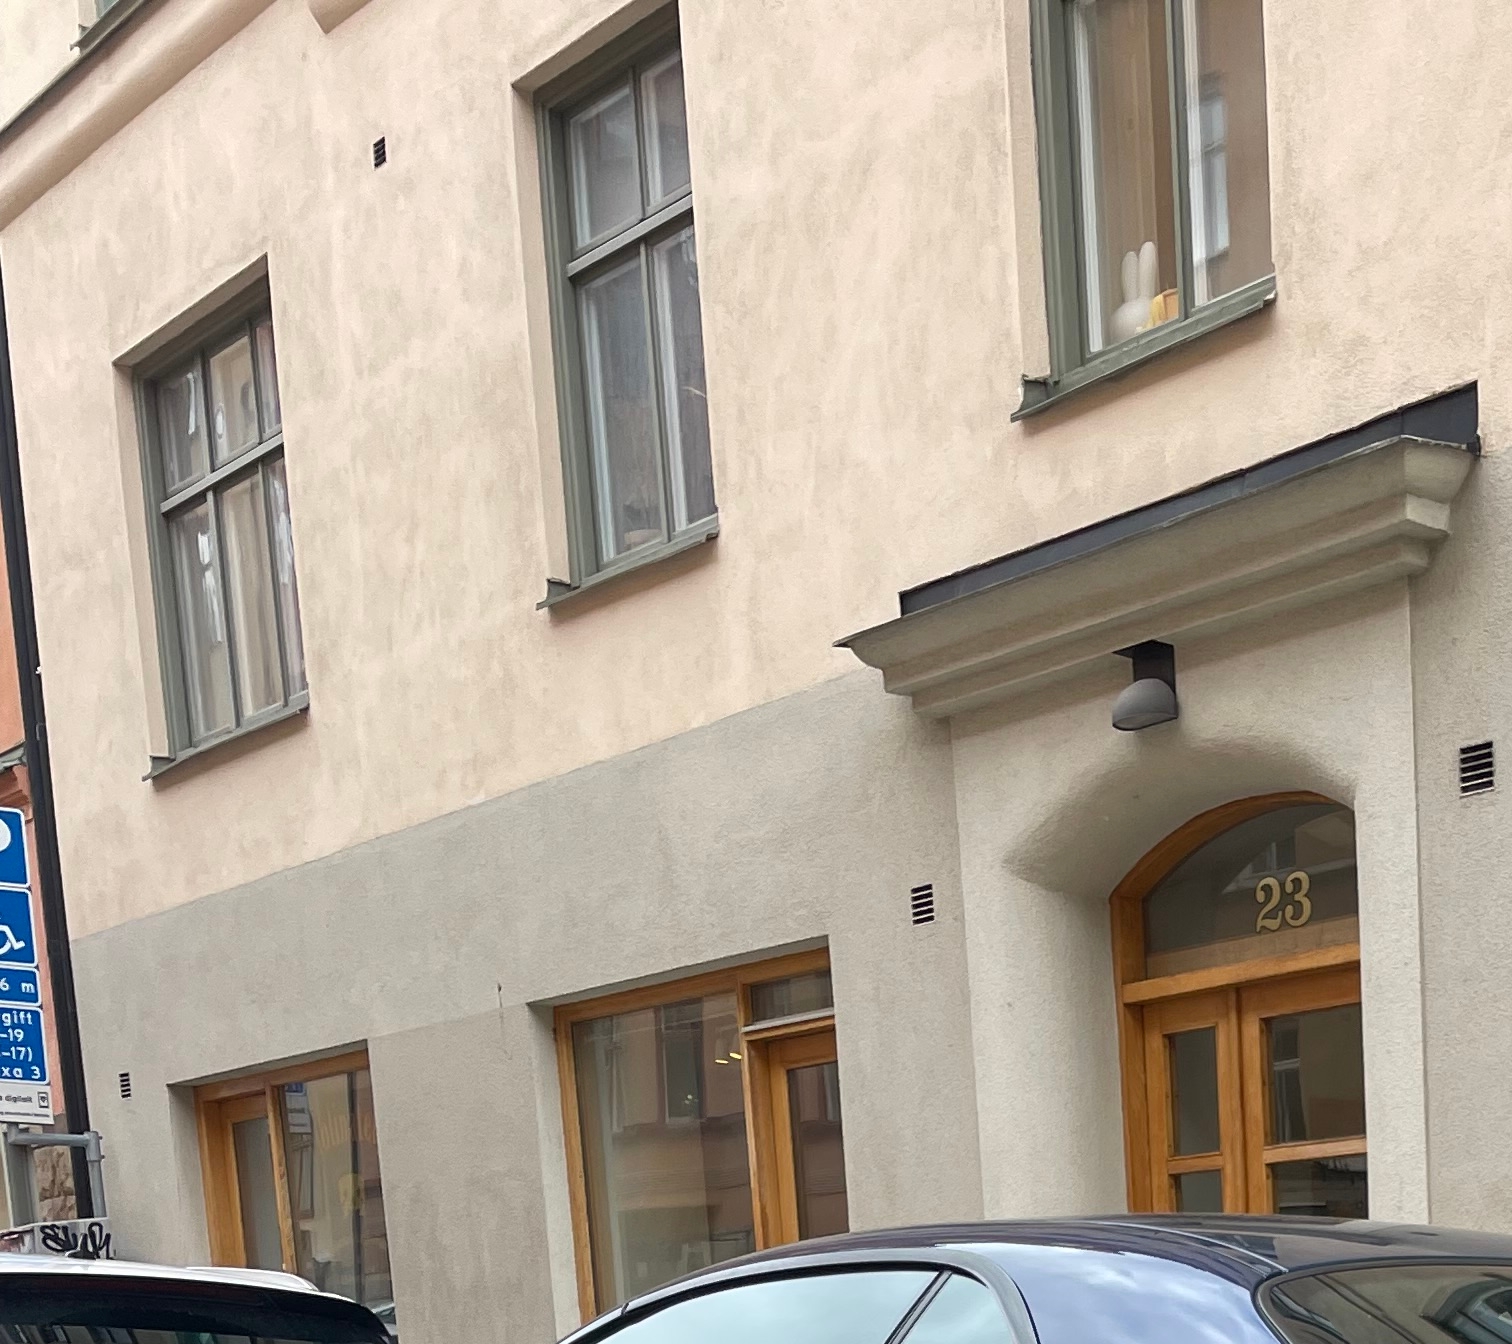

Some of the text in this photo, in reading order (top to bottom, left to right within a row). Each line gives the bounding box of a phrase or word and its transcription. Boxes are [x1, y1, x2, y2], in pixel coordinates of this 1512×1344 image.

[1255, 870, 1312, 933] 23
[21, 982, 35, 993] m
[31, 1065, 41, 1079] 3
